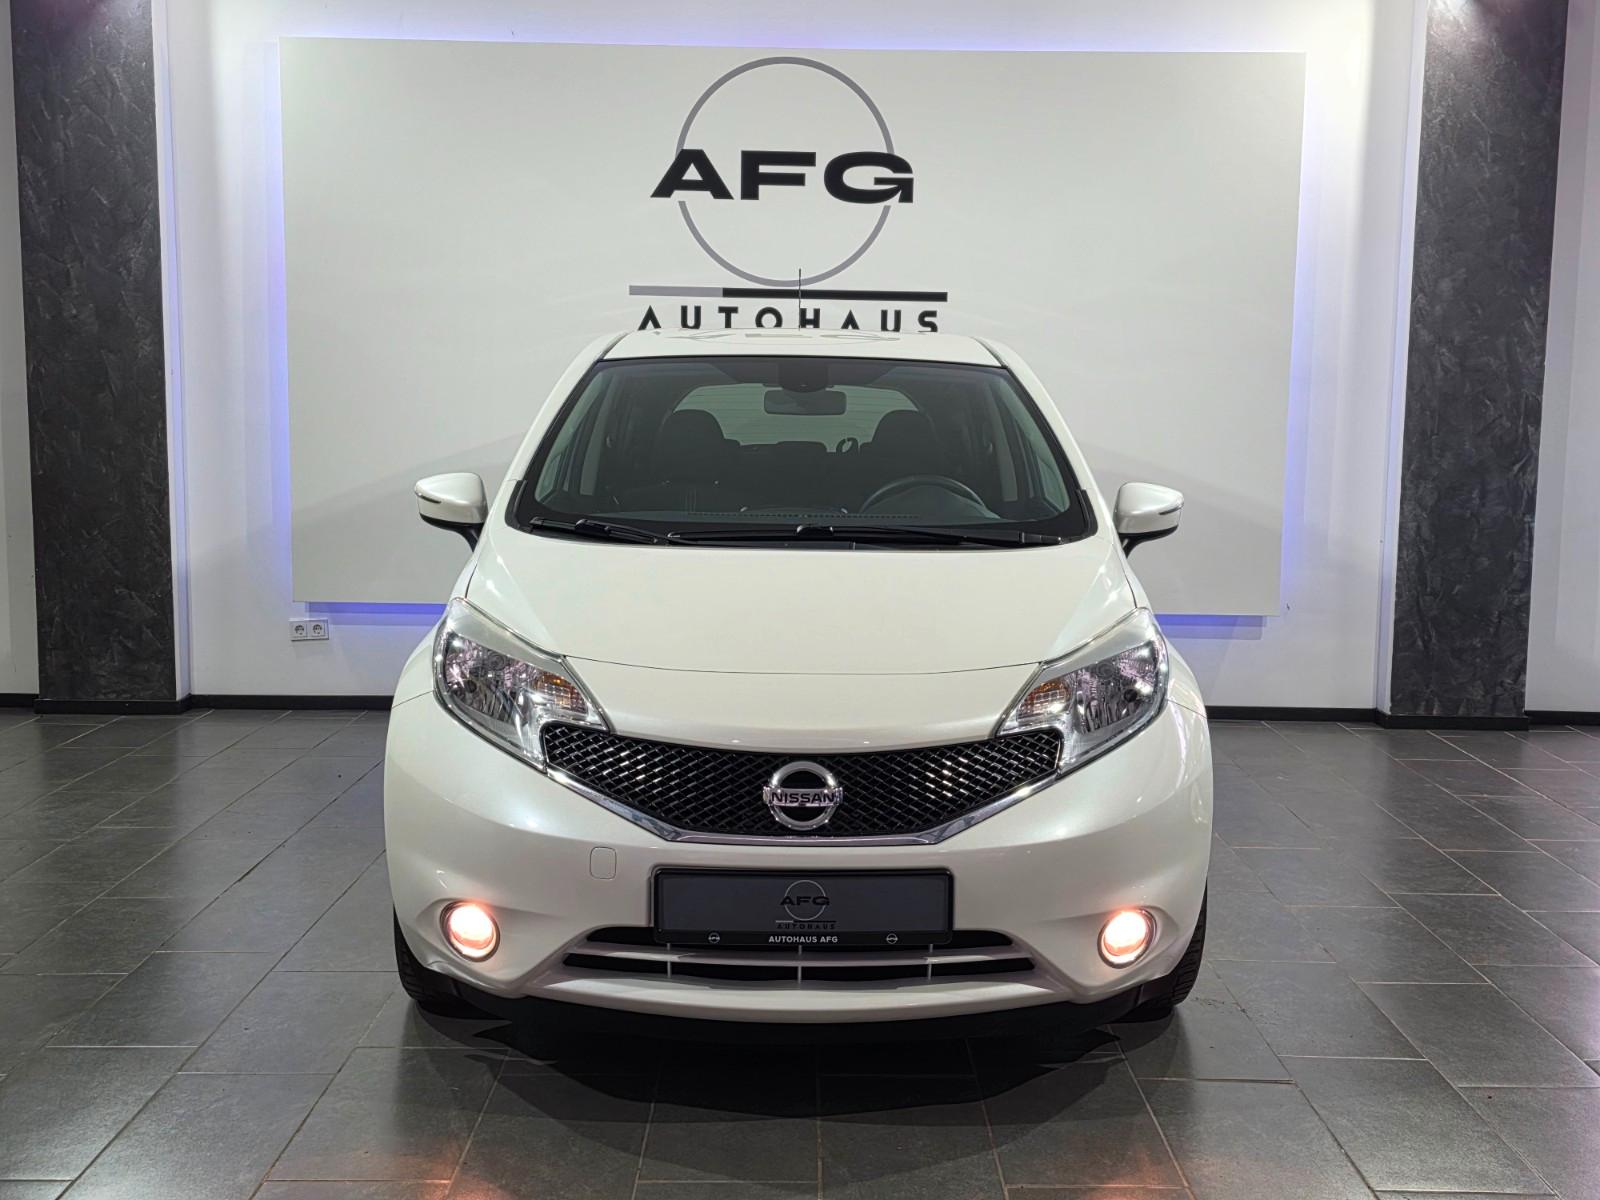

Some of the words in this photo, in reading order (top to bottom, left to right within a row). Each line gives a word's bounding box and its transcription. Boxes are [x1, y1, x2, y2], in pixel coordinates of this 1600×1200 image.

[650, 148, 914, 204] AFG
[637, 304, 938, 332] AUTOHAUS
[772, 792, 835, 804] NISSAN
[780, 896, 830, 906] AFG
[768, 935, 818, 943] AUTOHAUS
[820, 935, 838, 943] AFG
